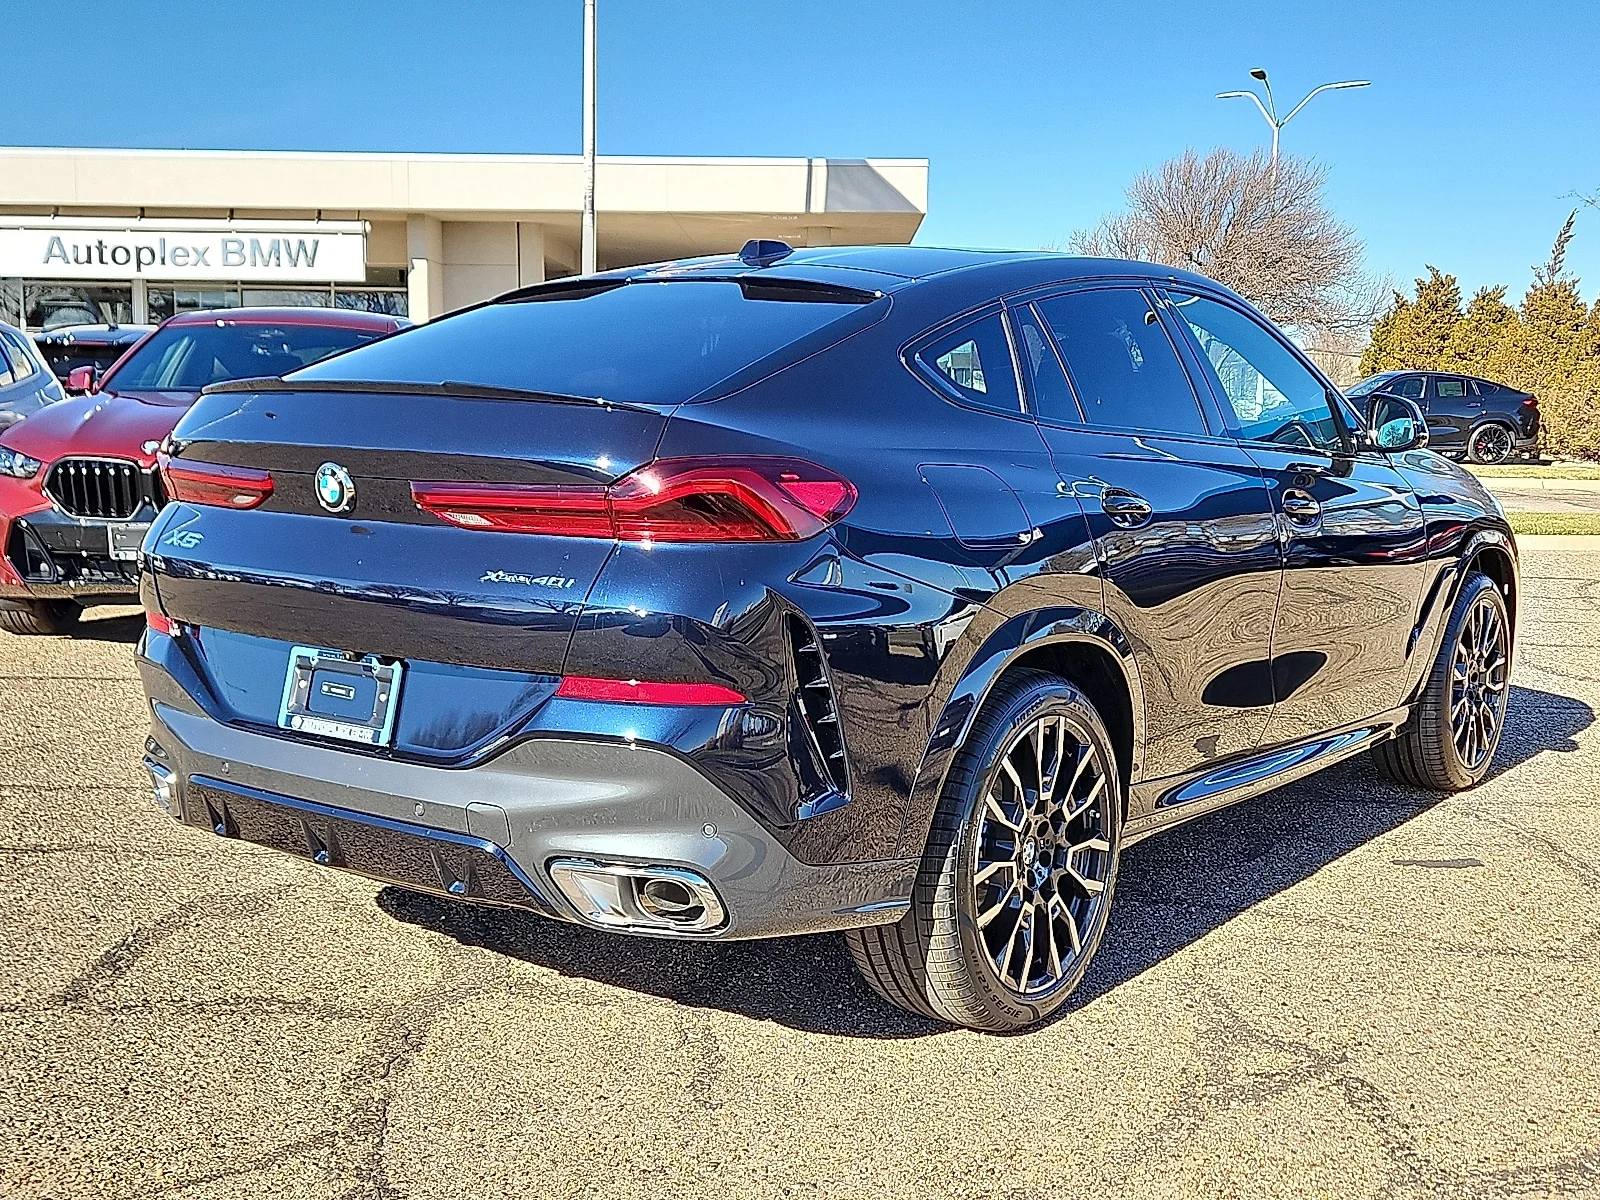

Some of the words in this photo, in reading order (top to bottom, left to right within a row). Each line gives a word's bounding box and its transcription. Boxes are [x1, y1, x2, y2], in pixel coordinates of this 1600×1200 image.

[43, 235, 211, 272] Autoplex
[221, 237, 319, 268] BMW
[163, 529, 206, 549] X6
